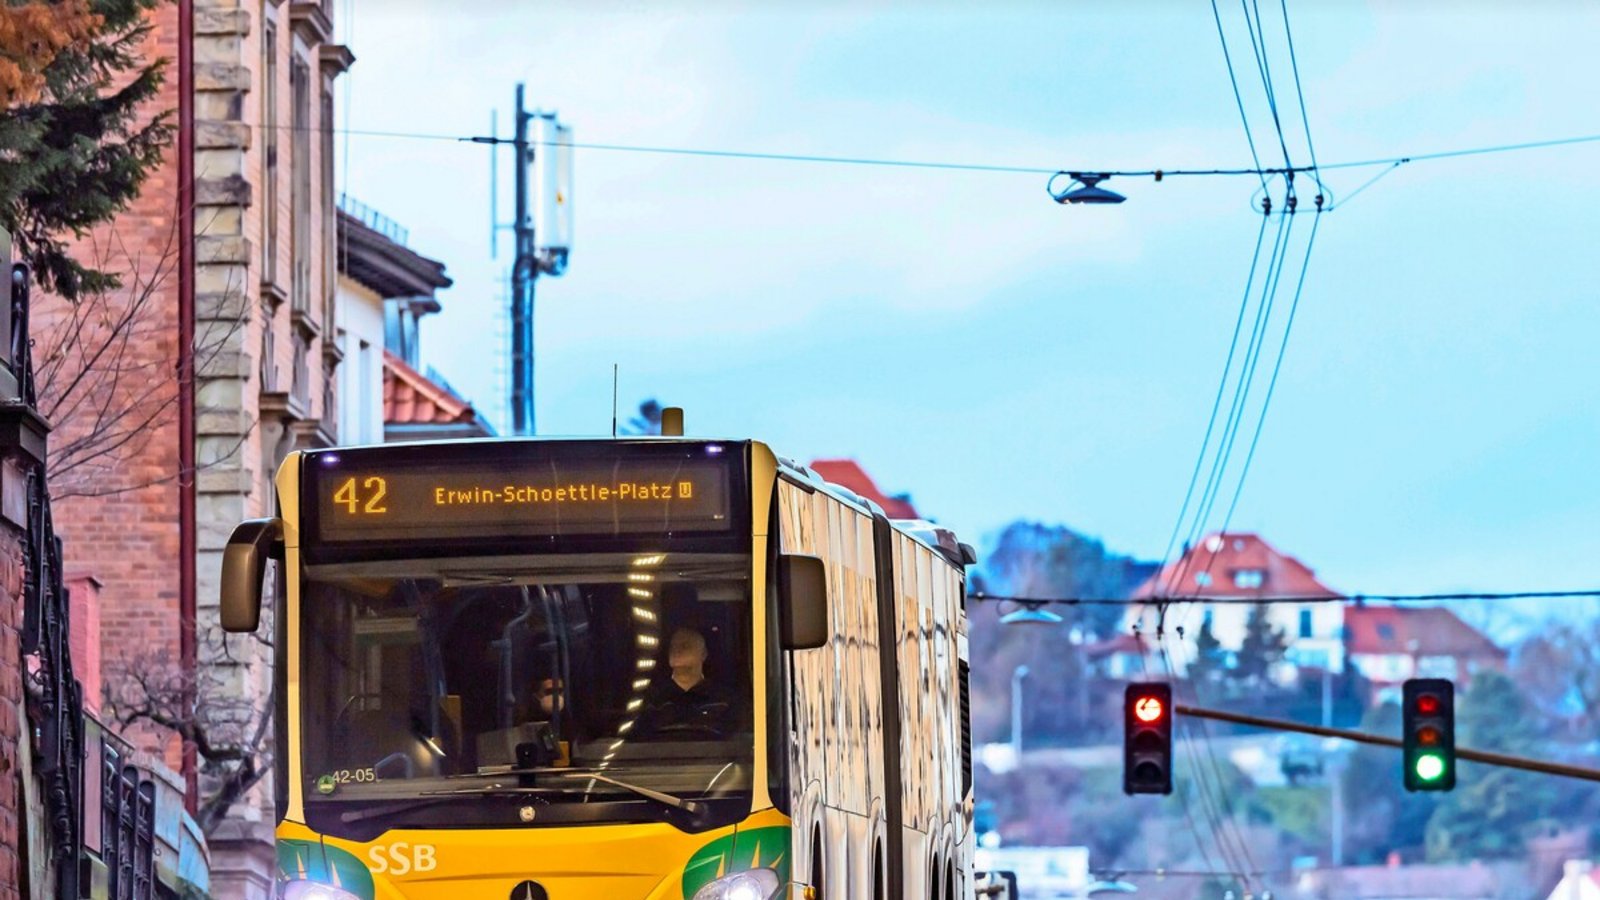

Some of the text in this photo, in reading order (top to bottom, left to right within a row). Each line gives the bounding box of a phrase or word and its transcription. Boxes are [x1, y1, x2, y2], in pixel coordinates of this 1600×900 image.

[334, 477, 388, 513] 42
[436, 482, 672, 505] Erwin-Schoettle-Platz
[332, 767, 375, 784] 42-05
[368, 842, 437, 875] SSB
